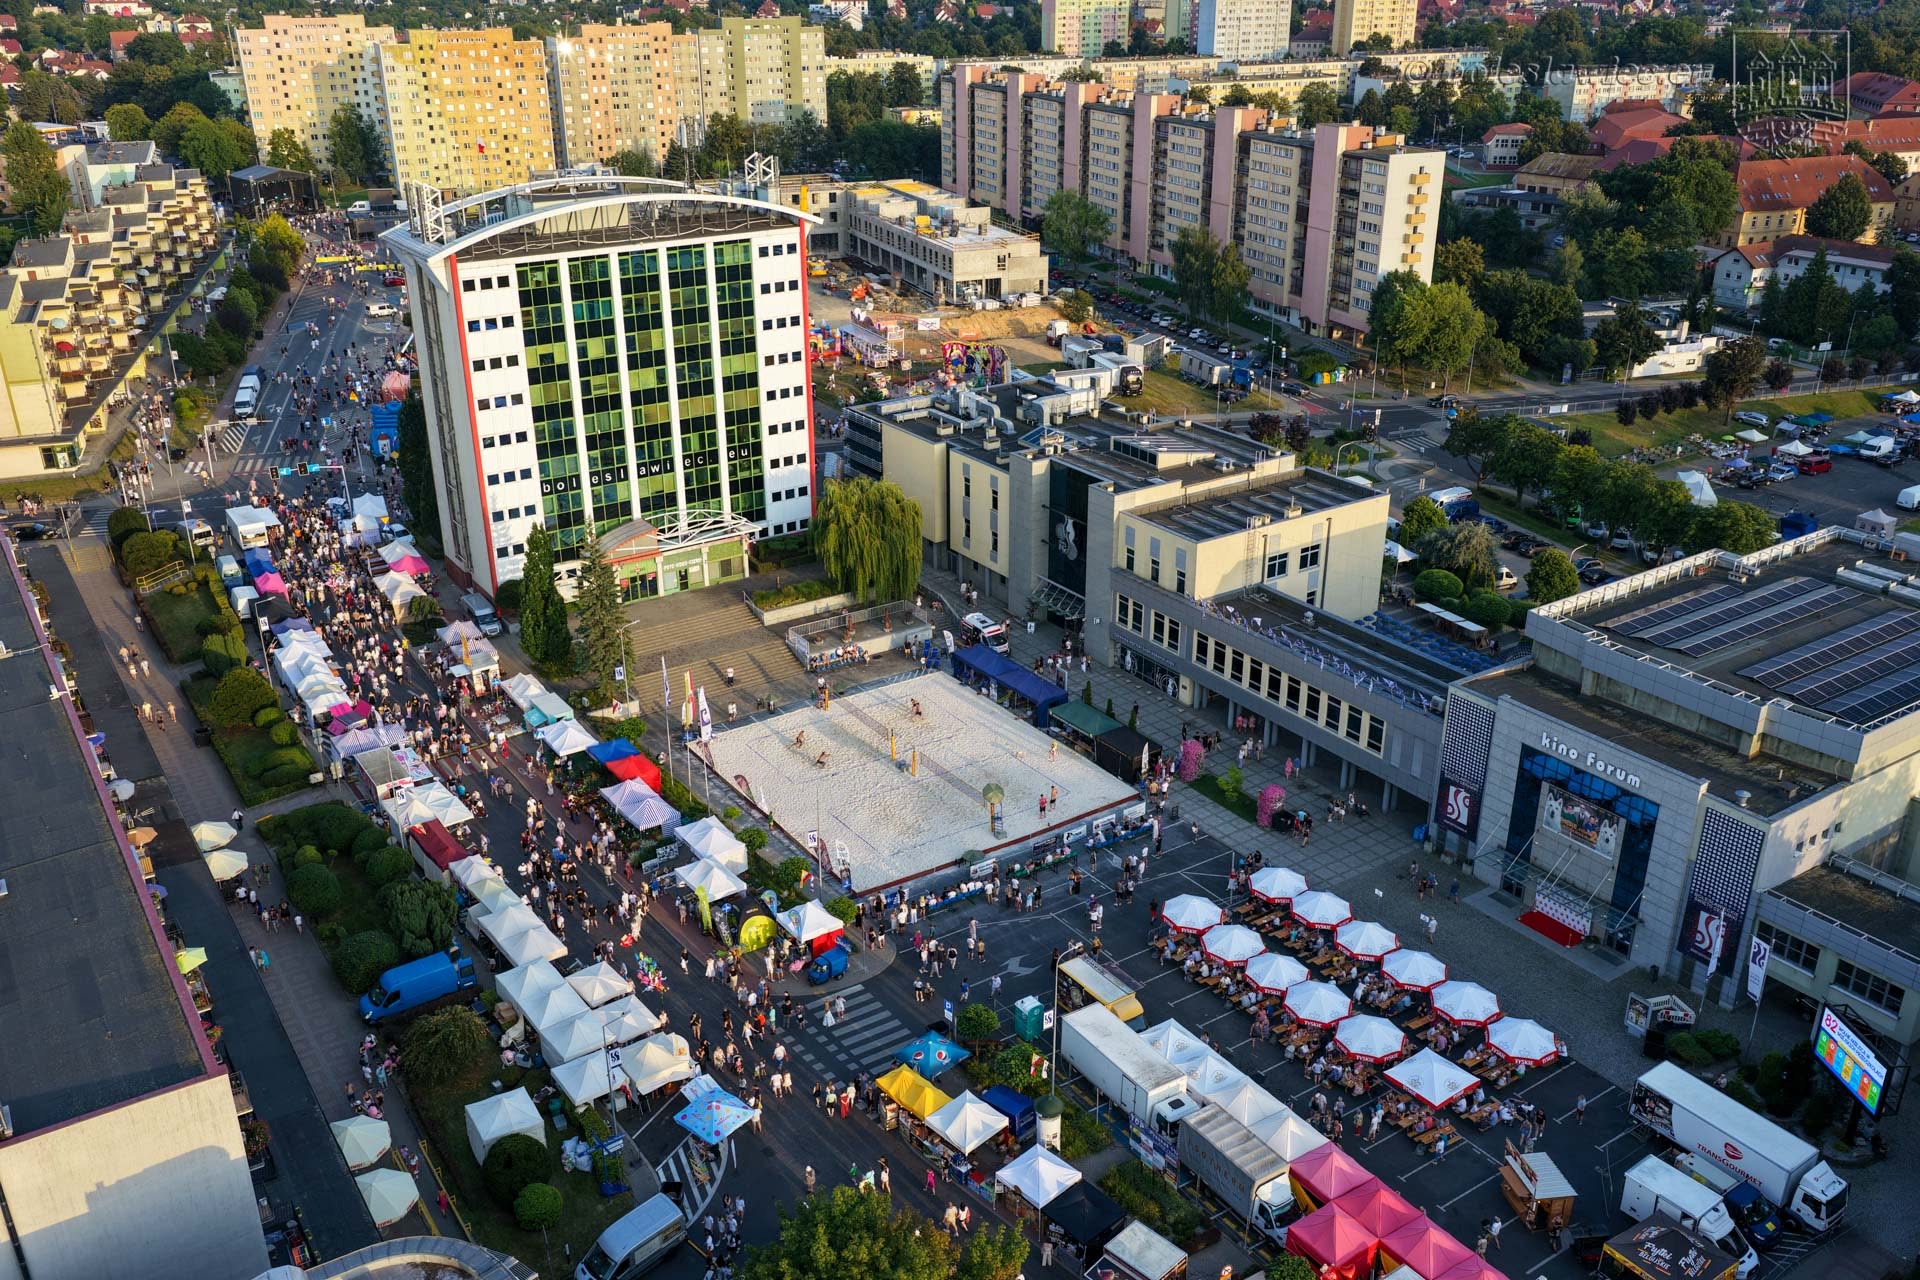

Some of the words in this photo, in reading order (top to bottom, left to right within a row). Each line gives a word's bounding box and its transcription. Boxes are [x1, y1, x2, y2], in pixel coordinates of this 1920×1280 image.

[1541, 732, 1578, 760] kino
[1586, 752, 1640, 788] Forum
[1824, 1013, 1839, 1034] 82
[1697, 1142, 1763, 1188] TRANSGOURMET
